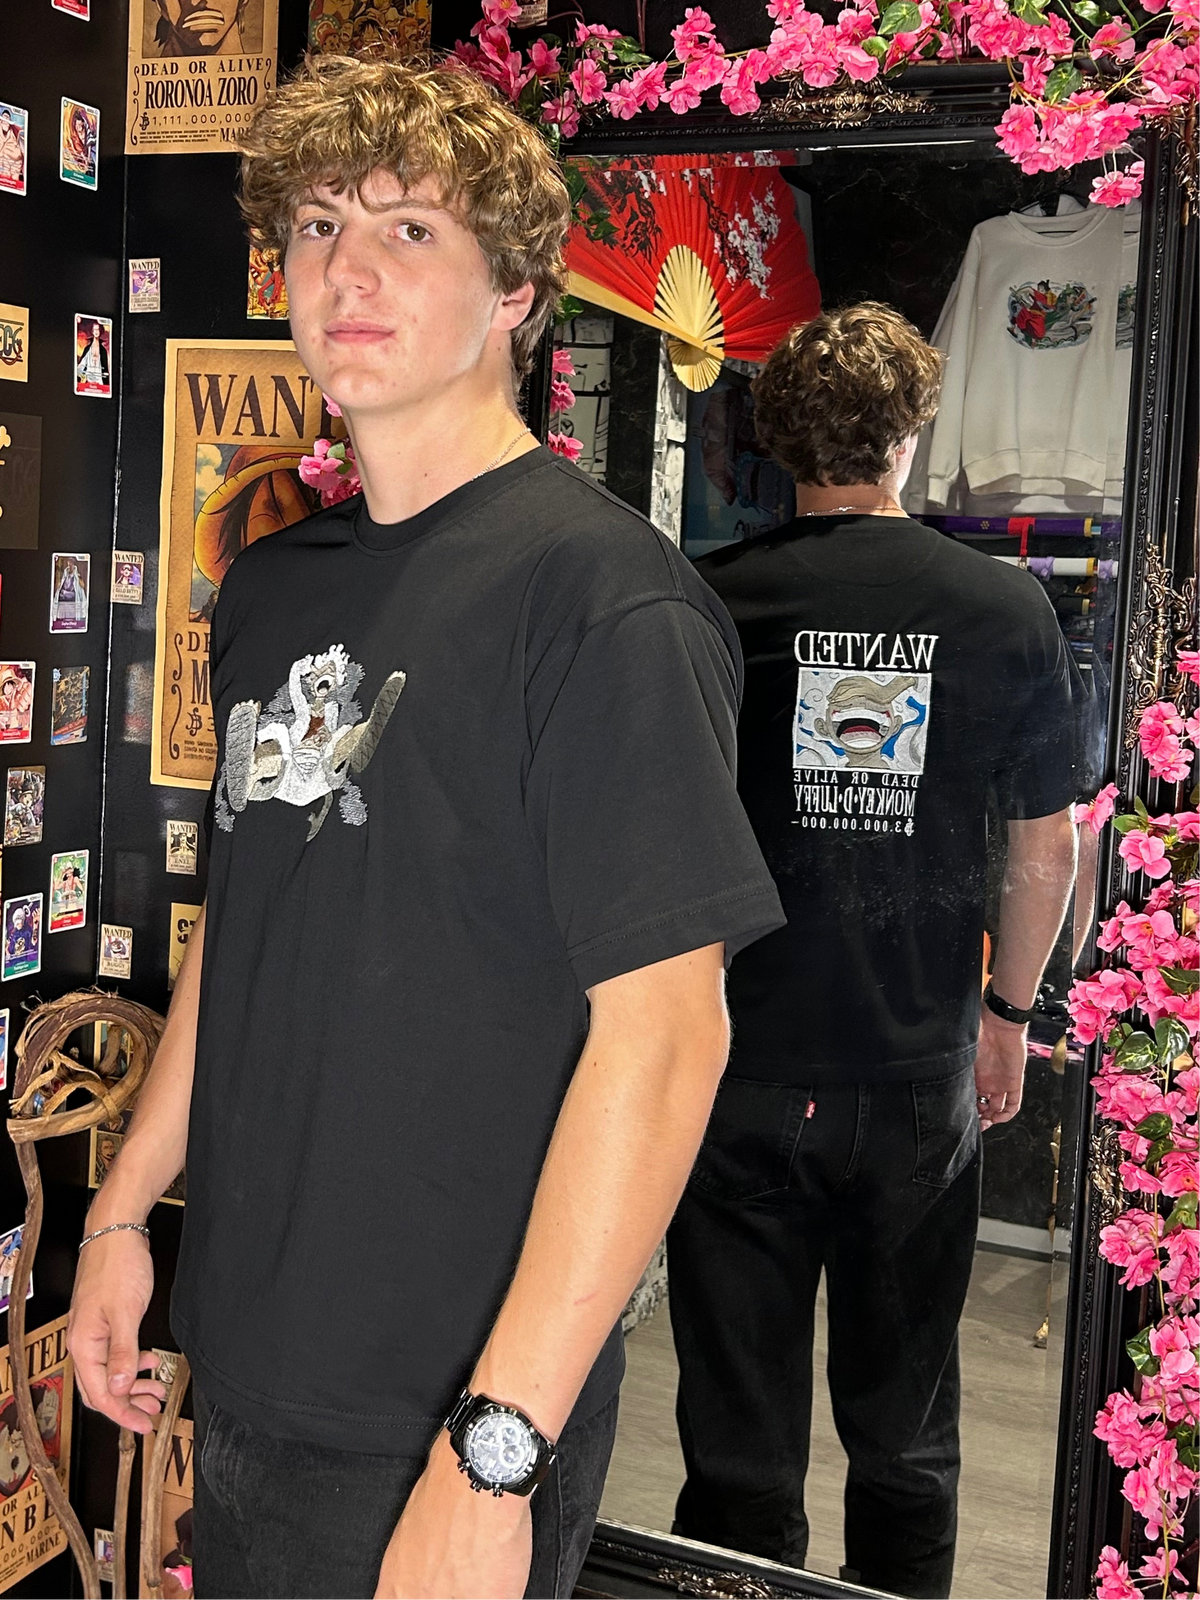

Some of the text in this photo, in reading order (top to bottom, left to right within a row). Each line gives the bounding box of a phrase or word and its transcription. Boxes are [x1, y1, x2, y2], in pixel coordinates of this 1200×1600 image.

[141, 57, 264, 77] DEAD OR ALIVE
[144, 76, 258, 109] RORONOA ZORO
[131, 261, 159, 270] WANTED
[115, 553, 144, 563] WANTED
[169, 823, 197, 833] WANTED
[104, 927, 132, 939] WANTED
[2, 1498, 17, 1517] OR
[26, 1531, 61, 1566] MARINE
